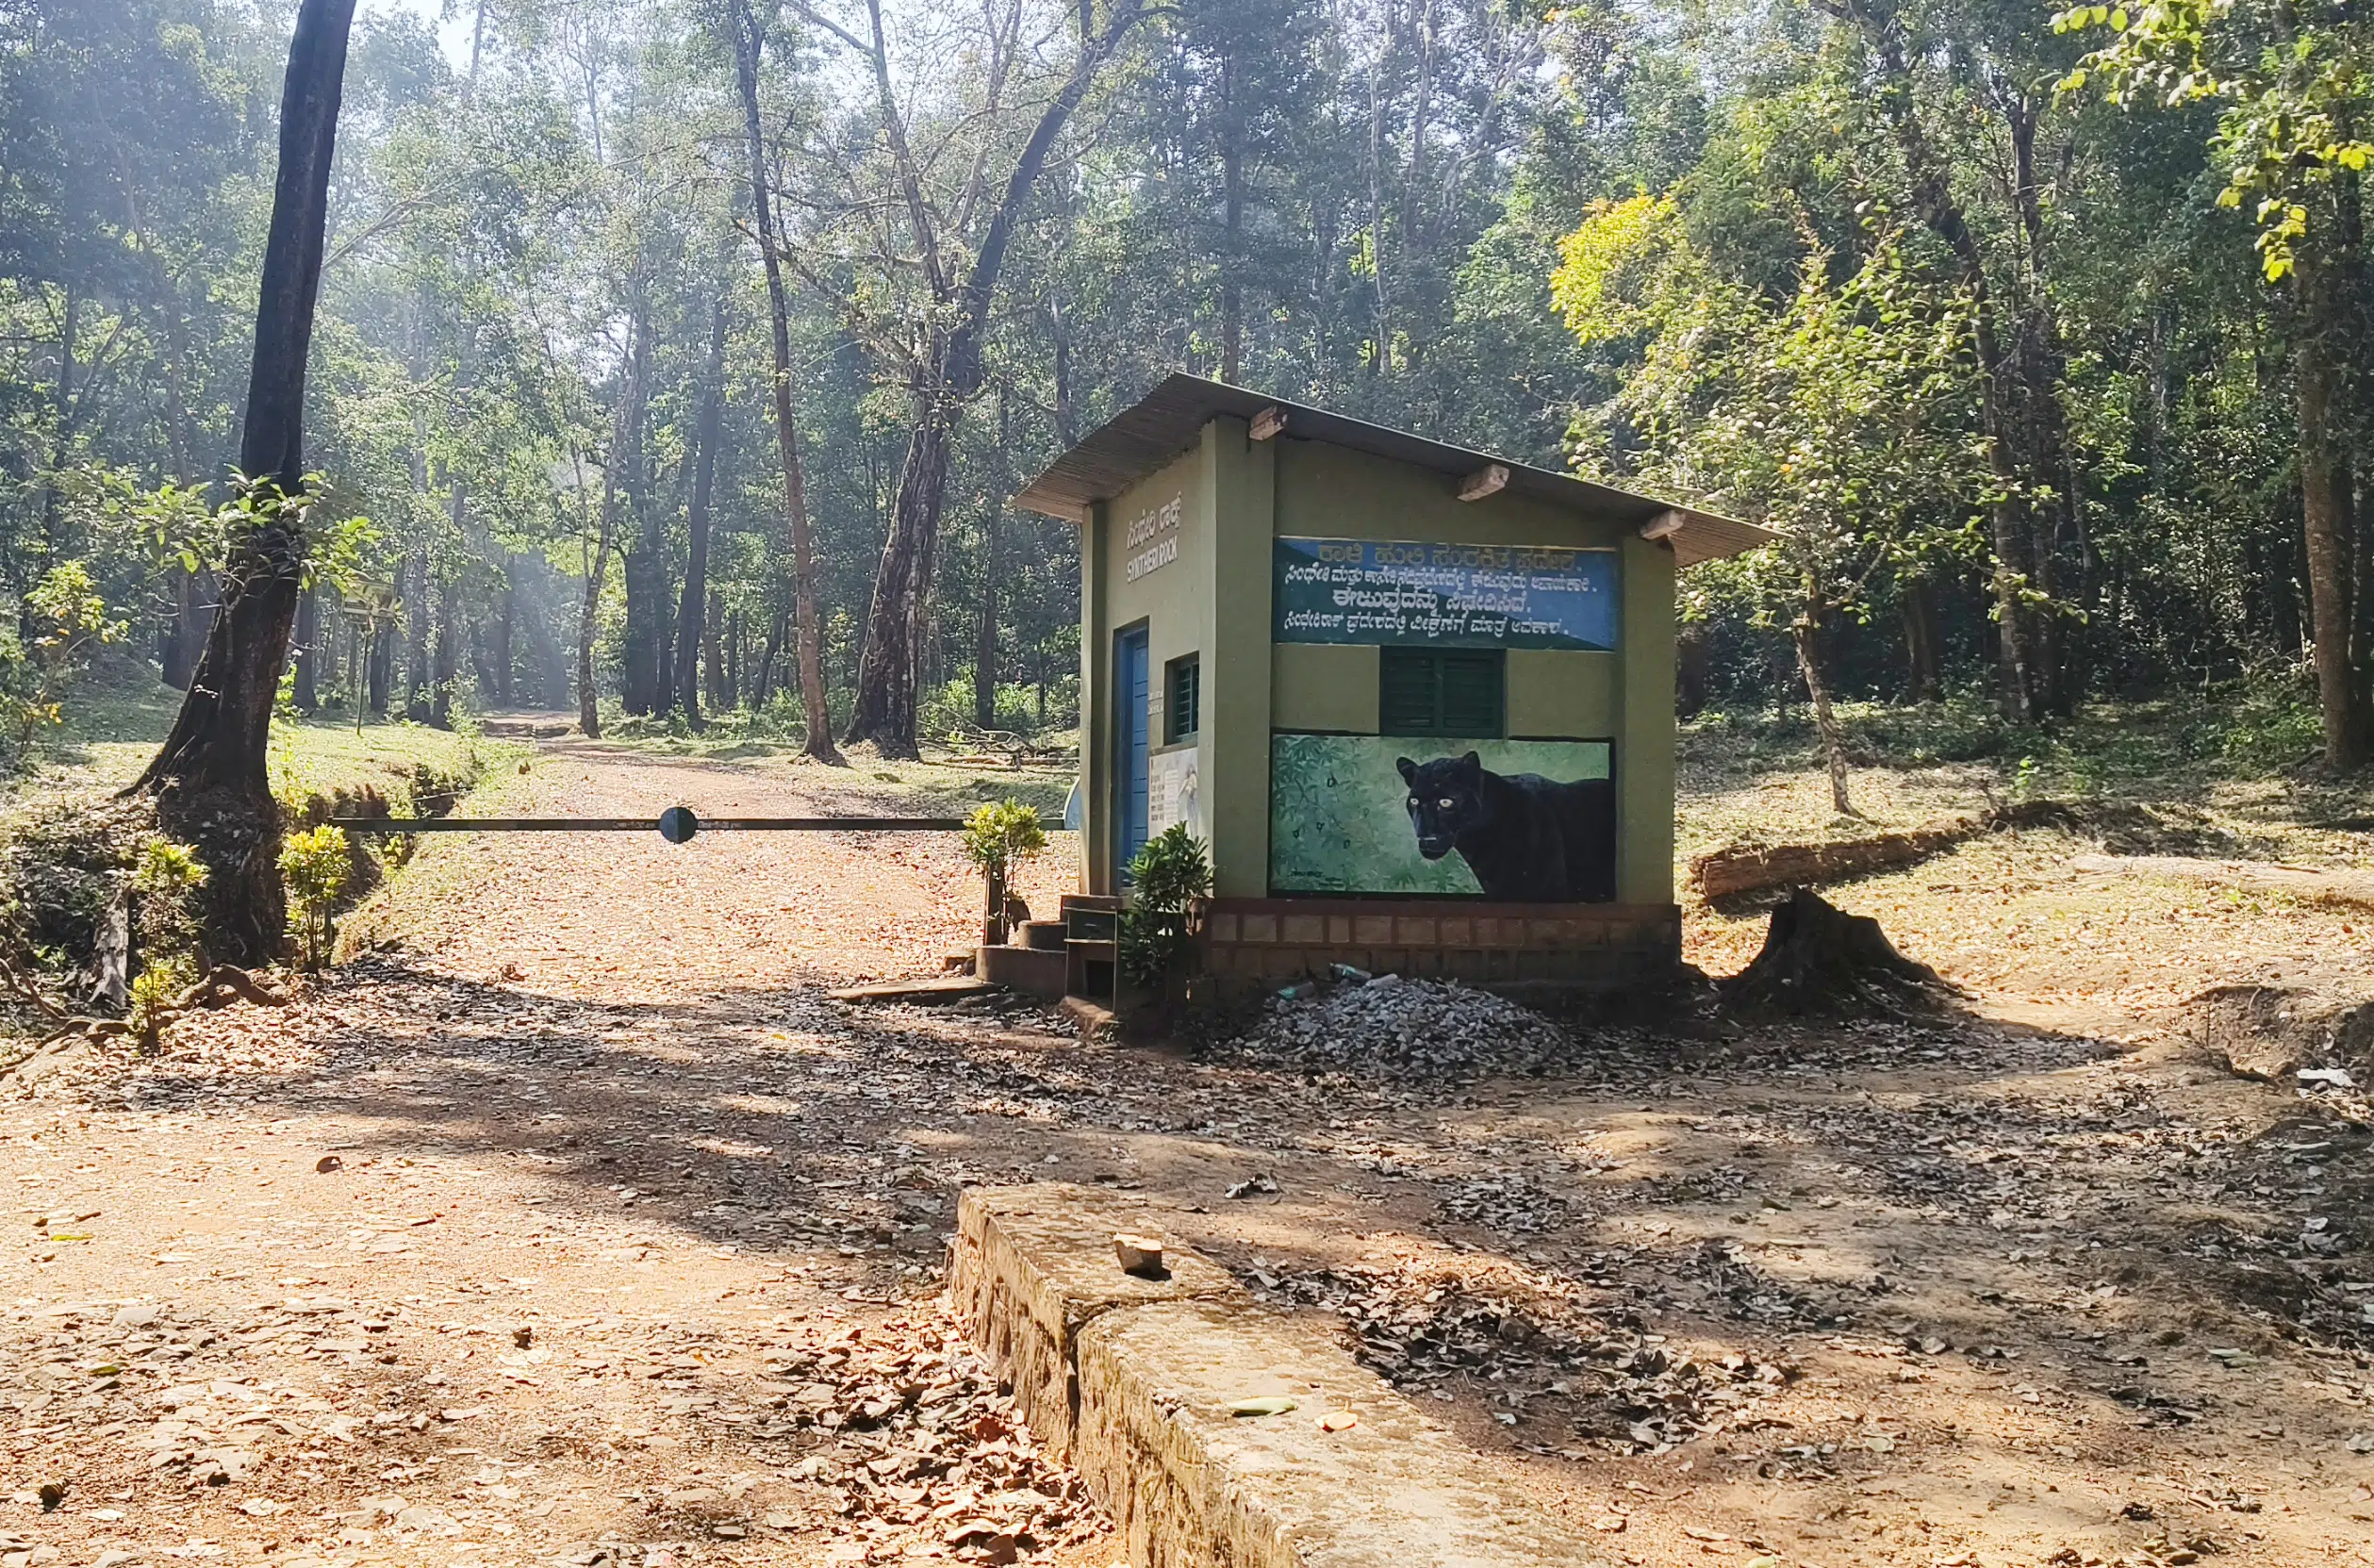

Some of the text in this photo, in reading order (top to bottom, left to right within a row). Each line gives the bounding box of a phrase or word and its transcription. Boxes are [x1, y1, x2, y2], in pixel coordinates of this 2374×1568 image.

[1128, 535, 1178, 583] SYNTHERI ROCK
[1331, 565, 1362, 586] ಮತ್ತು
[1471, 615, 1508, 637] ಮಾತ್ರ
